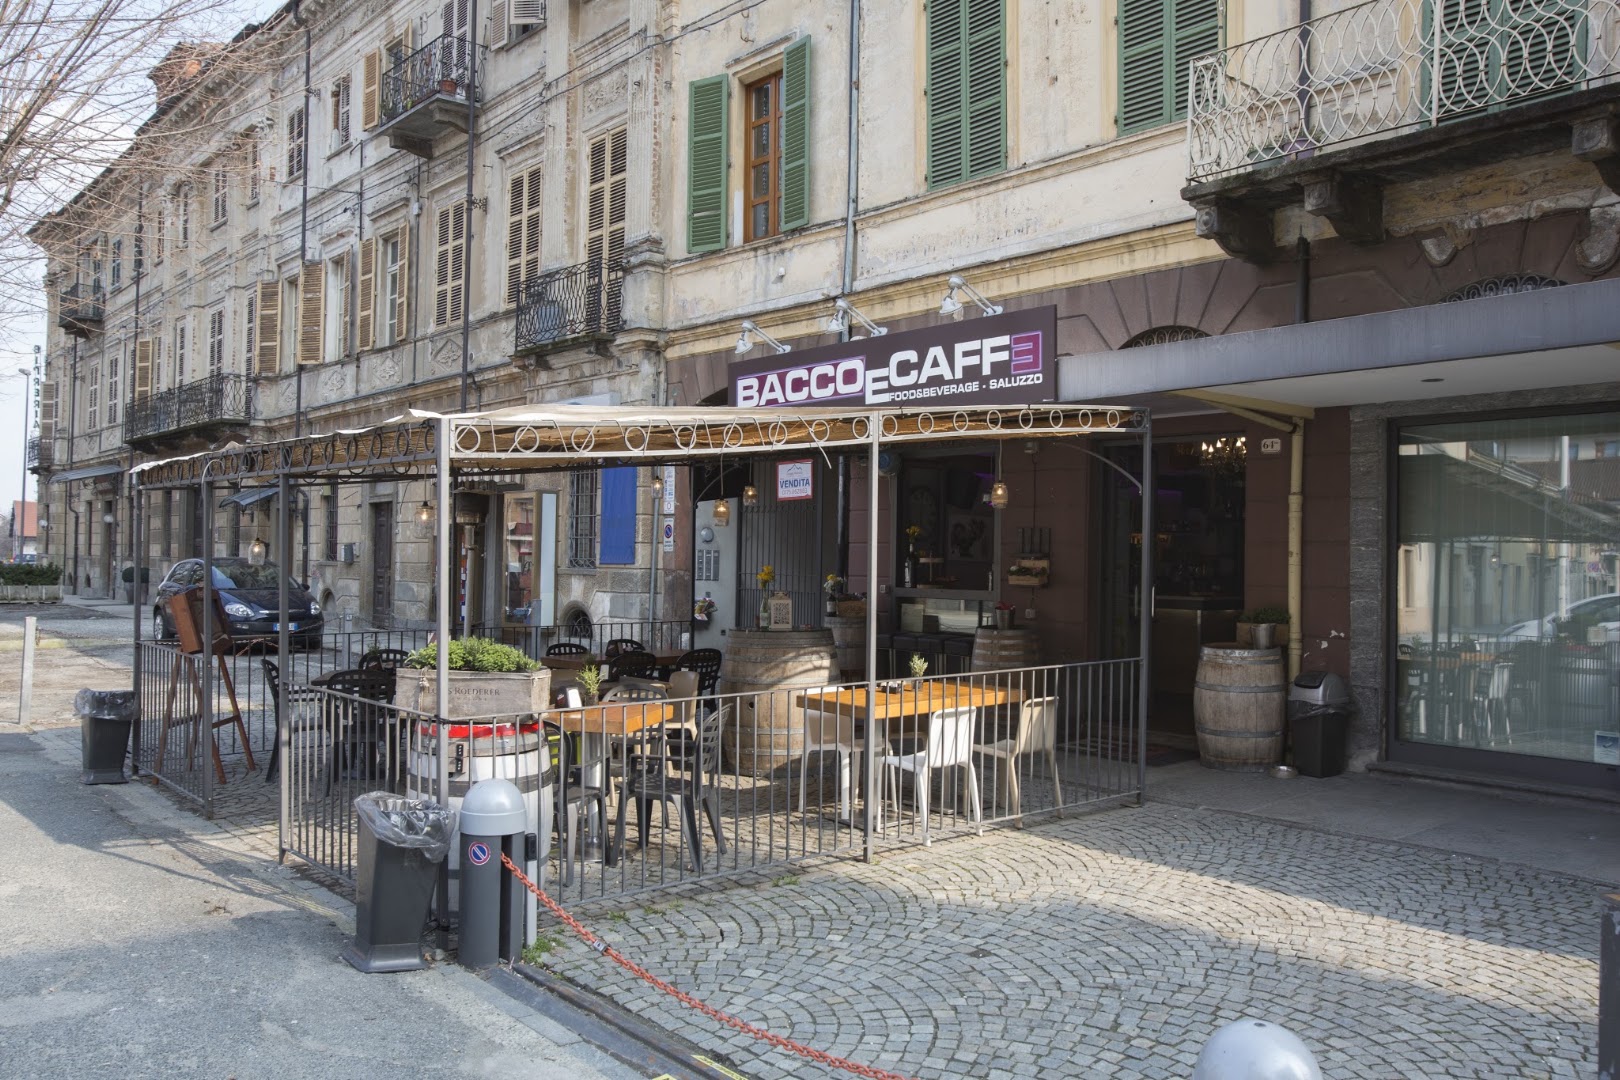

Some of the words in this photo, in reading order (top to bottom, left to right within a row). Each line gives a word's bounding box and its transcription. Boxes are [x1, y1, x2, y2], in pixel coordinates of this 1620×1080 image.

[737, 359, 864, 407] BACCO
[865, 367, 890, 405] E
[889, 381, 980, 402] FOOD&BEVERAGE
[989, 373, 1043, 390] SALUZZO
[779, 478, 810, 488] VENDITA
[454, 687, 500, 696] ROEDERER
